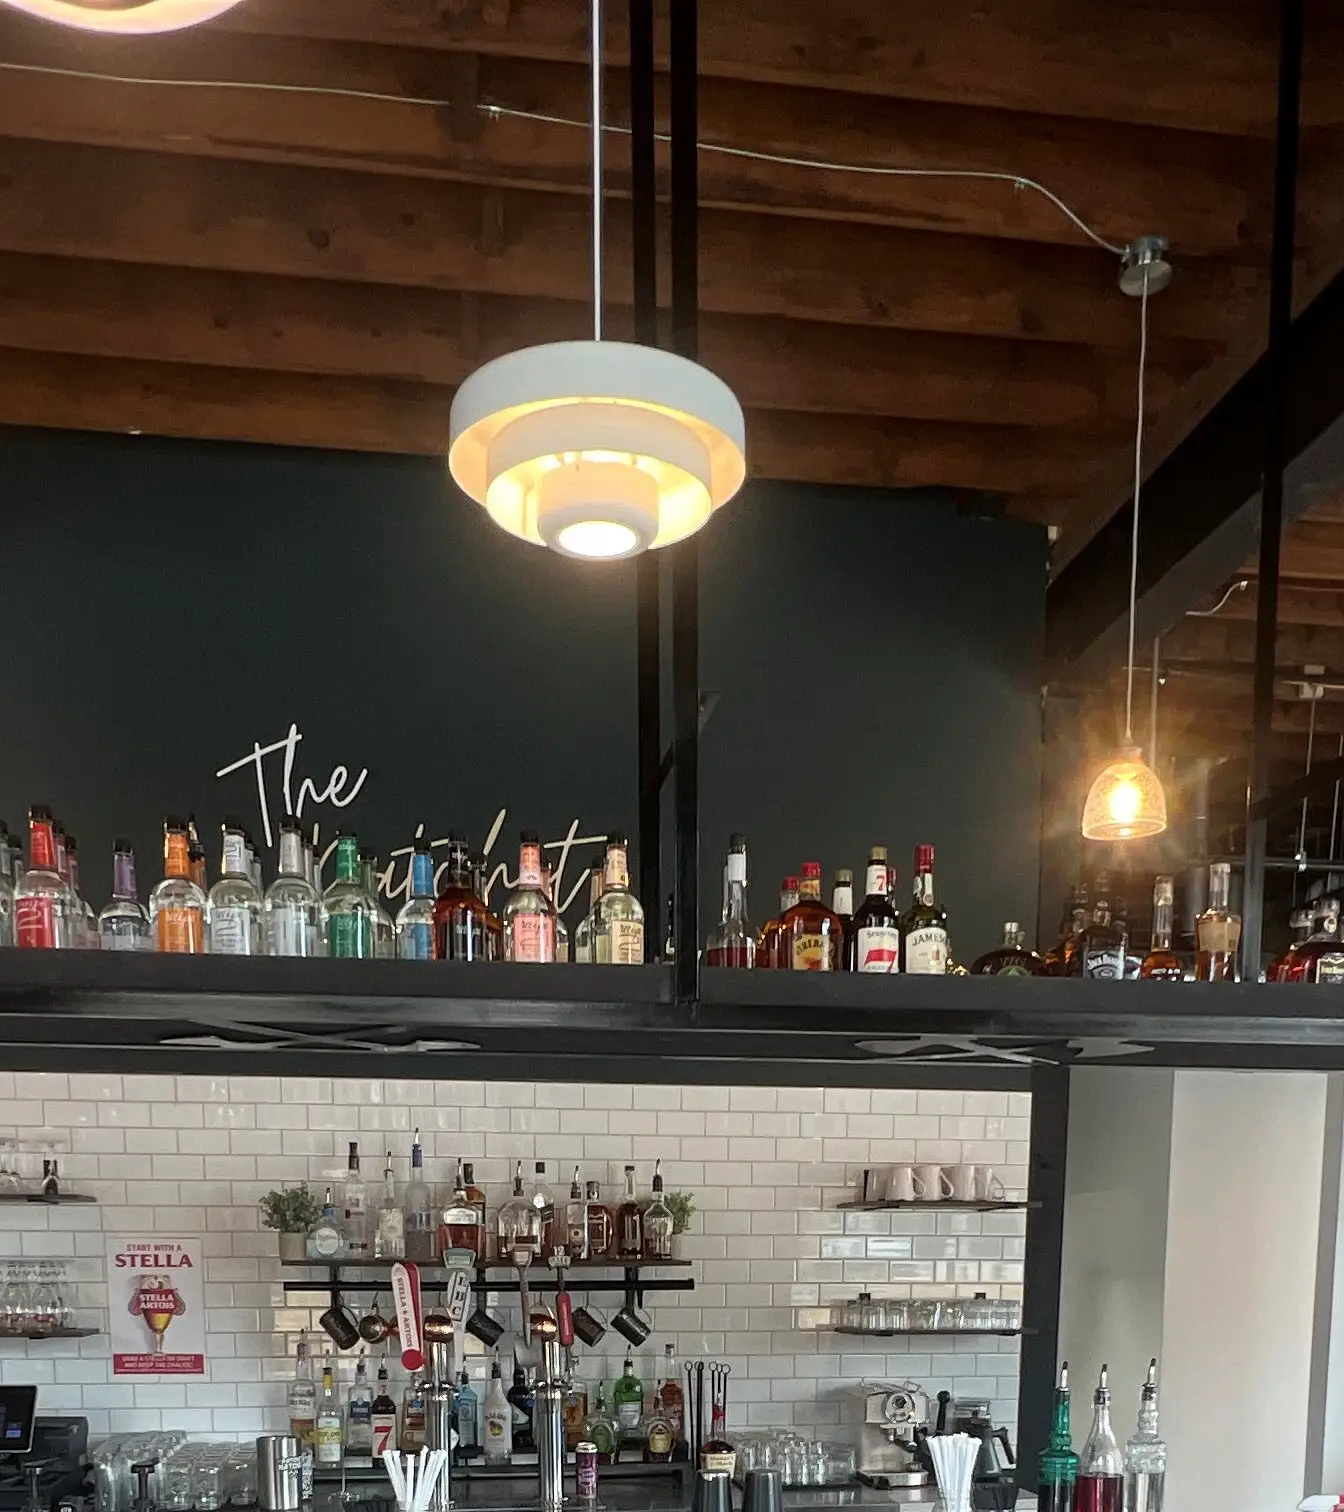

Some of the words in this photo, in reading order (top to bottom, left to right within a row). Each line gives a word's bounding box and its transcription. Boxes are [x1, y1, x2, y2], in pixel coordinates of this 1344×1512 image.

[216, 723, 367, 847] The
[876, 875, 885, 891] 7
[115, 1253, 193, 1268] STELLA
[139, 1293, 174, 1301] STELLA
[139, 1301, 175, 1309] ARTOIS
[374, 1426, 393, 1456] 7
